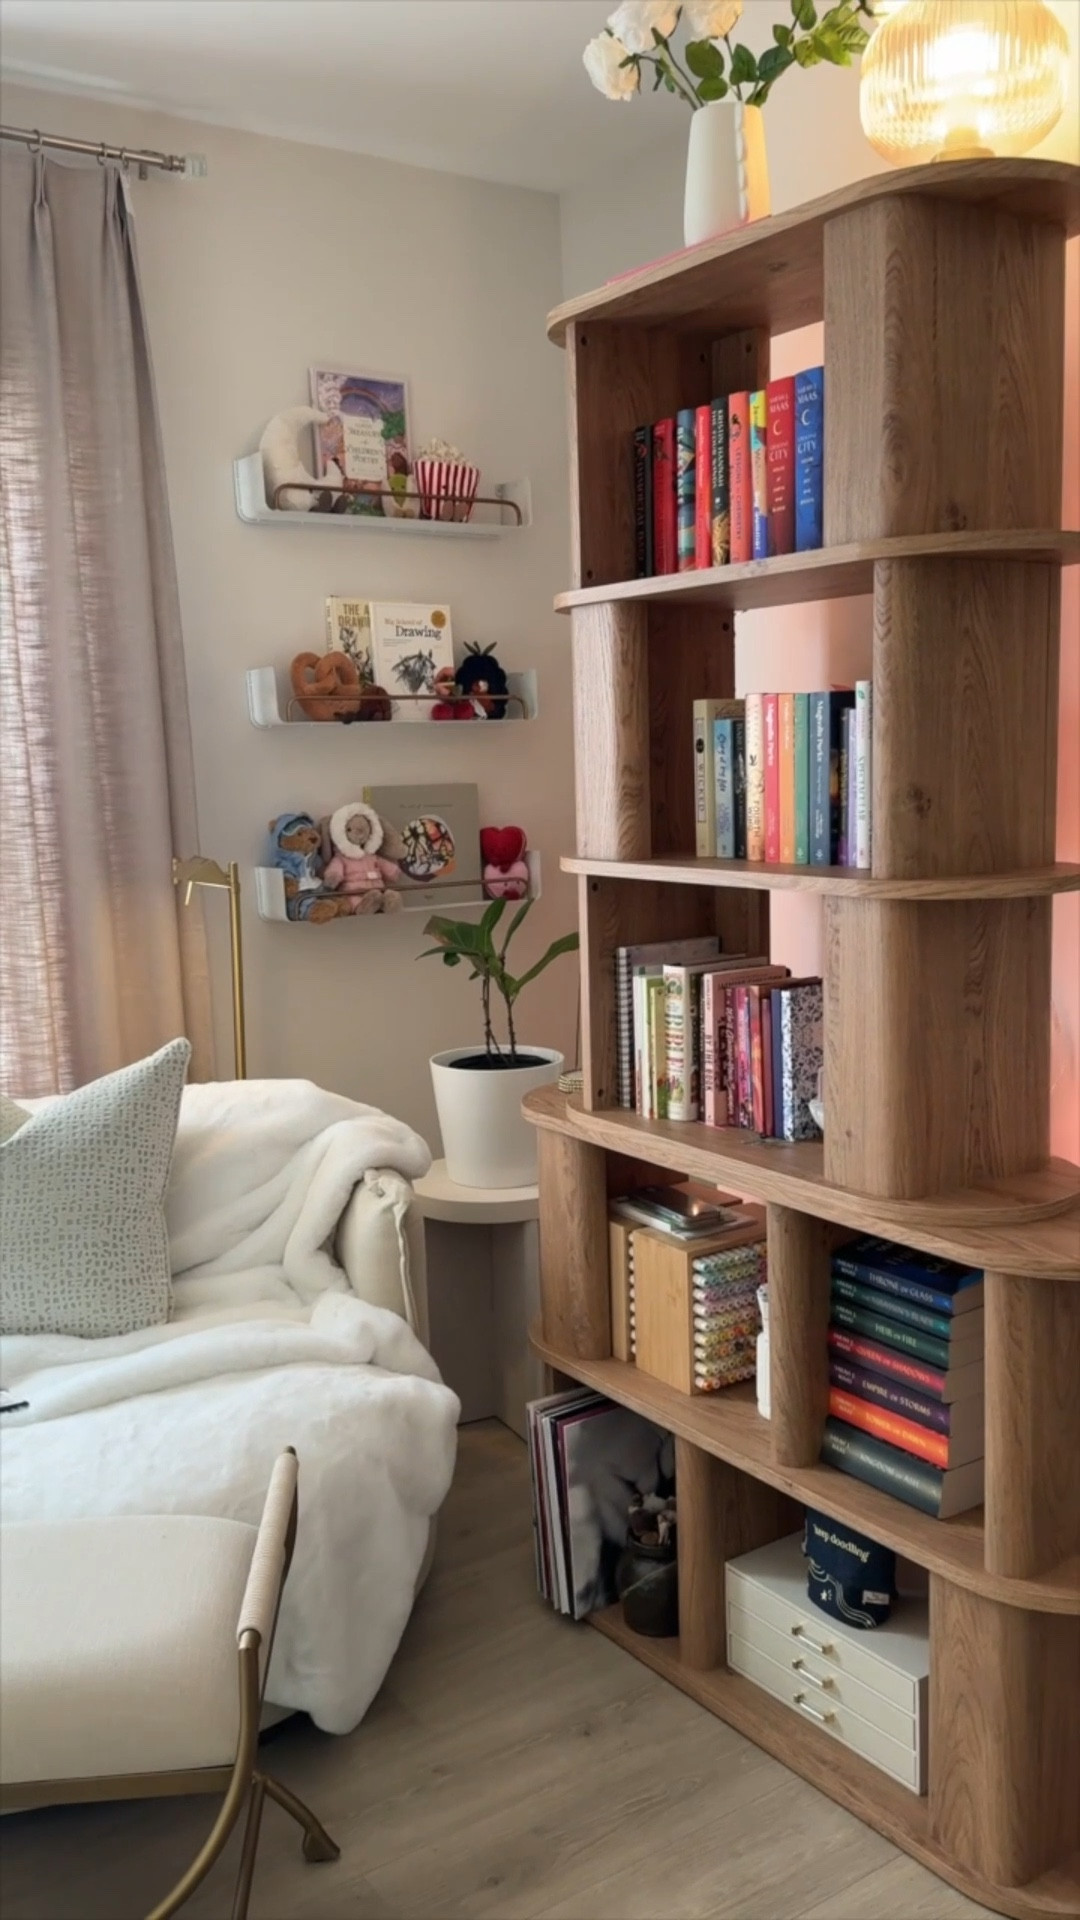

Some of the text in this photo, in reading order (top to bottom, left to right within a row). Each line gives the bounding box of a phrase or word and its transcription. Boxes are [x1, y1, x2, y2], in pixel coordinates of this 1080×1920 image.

[768, 448, 788, 462] CITY
[797, 440, 817, 454] CITY
[734, 447, 742, 484] LESSONS
[734, 495, 742, 540] CHEMISTRY
[343, 603, 360, 616] THE
[395, 625, 442, 641] Drawing
[815, 700, 824, 737] Magnolia
[816, 739, 824, 763] Parks
[698, 762, 706, 812] WICKED
[705, 1068, 713, 1091] BOOK
[869, 1272, 899, 1290] THRONE
[909, 1288, 934, 1303] GLASS
[875, 1323, 893, 1337] HEIR
[902, 1334, 917, 1348] FIRE
[862, 1380, 888, 1399] EMPIRE
[900, 1396, 931, 1417] STORMS
